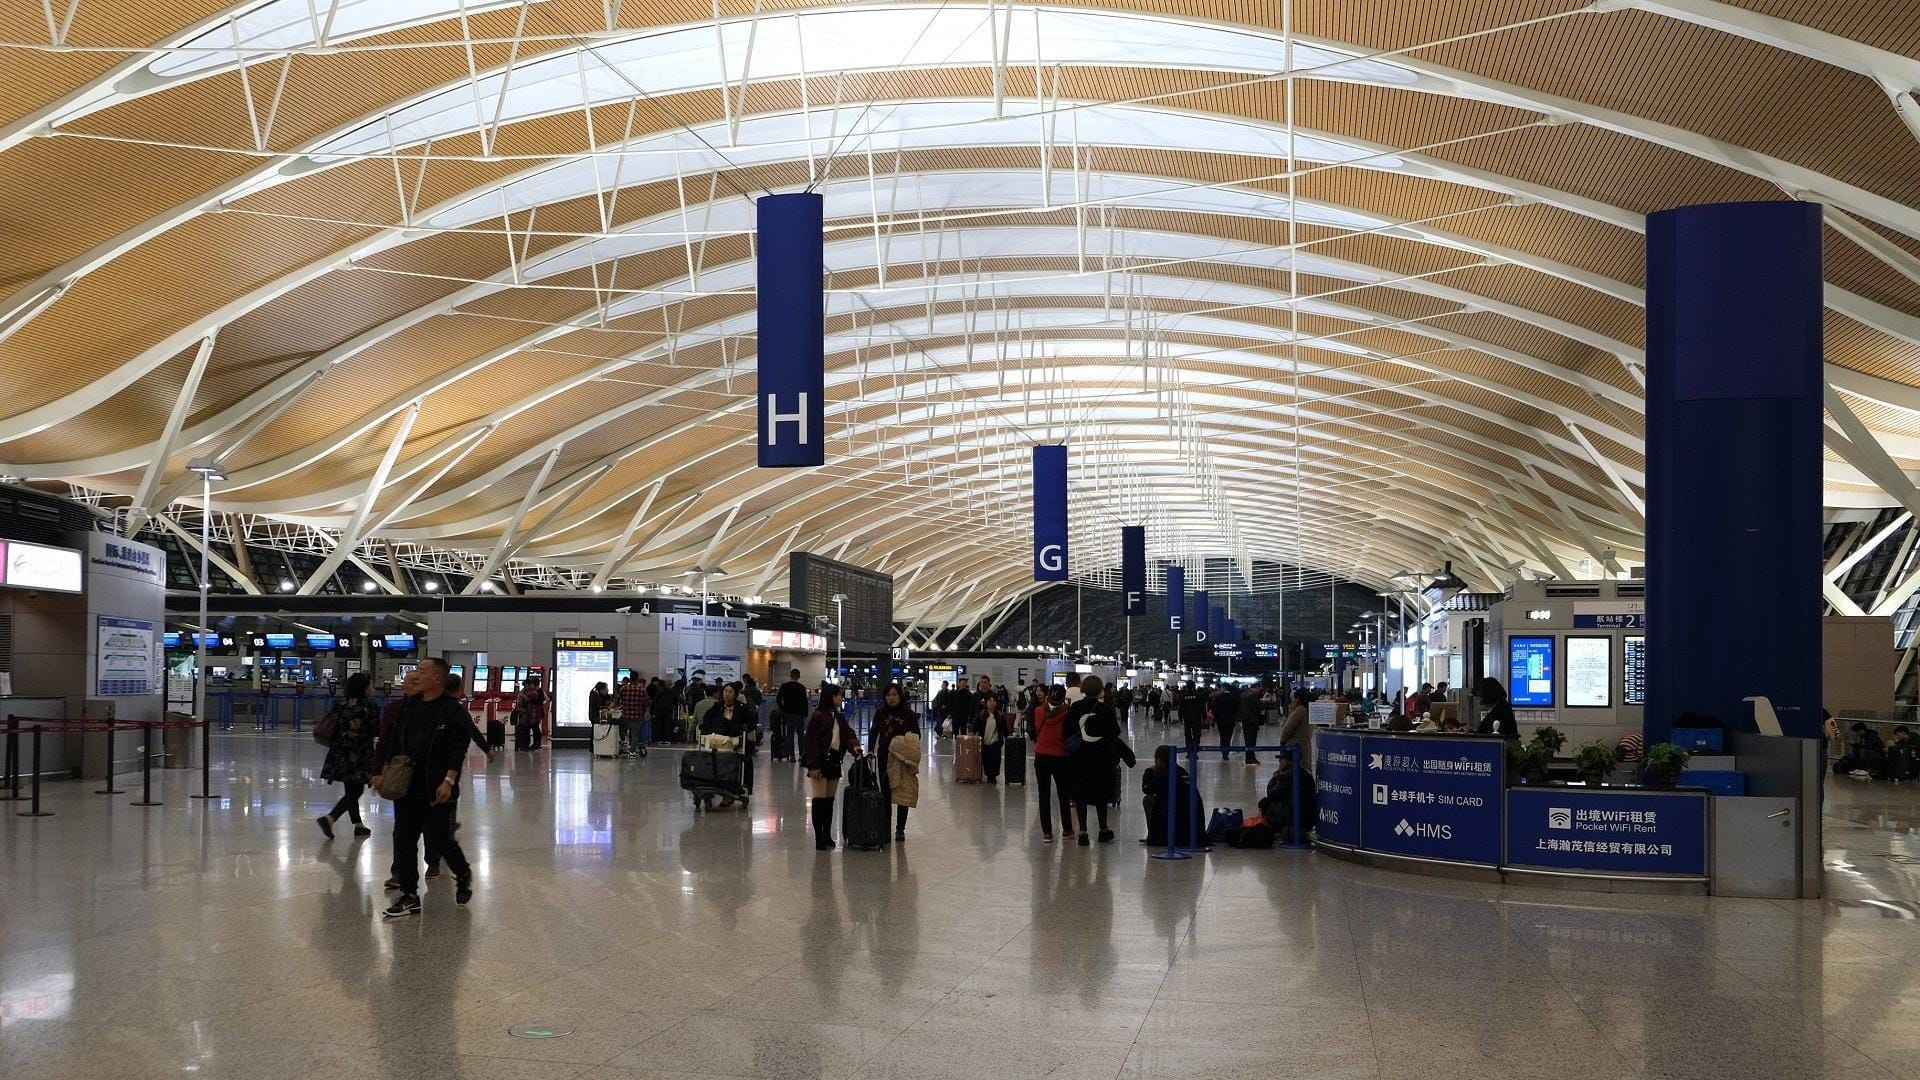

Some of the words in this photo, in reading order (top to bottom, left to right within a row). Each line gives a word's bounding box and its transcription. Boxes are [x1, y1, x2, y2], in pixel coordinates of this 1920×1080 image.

[768, 392, 808, 446] H
[1039, 544, 1062, 571] G
[1127, 591, 1140, 609] F
[664, 617, 674, 631] H
[1170, 615, 1181, 630] E
[1625, 614, 1635, 628] 2
[222, 638, 233, 646] 04
[253, 638, 264, 647] 03
[339, 638, 349, 647] 02
[1196, 630, 1206, 642] D
[372, 639, 382, 648] 01
[557, 640, 564, 648] H
[1391, 789, 1435, 804] 全球手机卡
[1438, 795, 1453, 805] SIM
[1456, 796, 1483, 807] CARD
[1324, 808, 1339, 825] HMS
[1576, 809, 1657, 824] 出境WiFi租赁
[1416, 822, 1452, 840] HMS
[1575, 822, 1607, 831] Pocket
[1609, 823, 1631, 832] WiFi
[1634, 824, 1657, 833] Rent
[1535, 838, 1673, 856] 上海瀚茂信经贸有限公司
